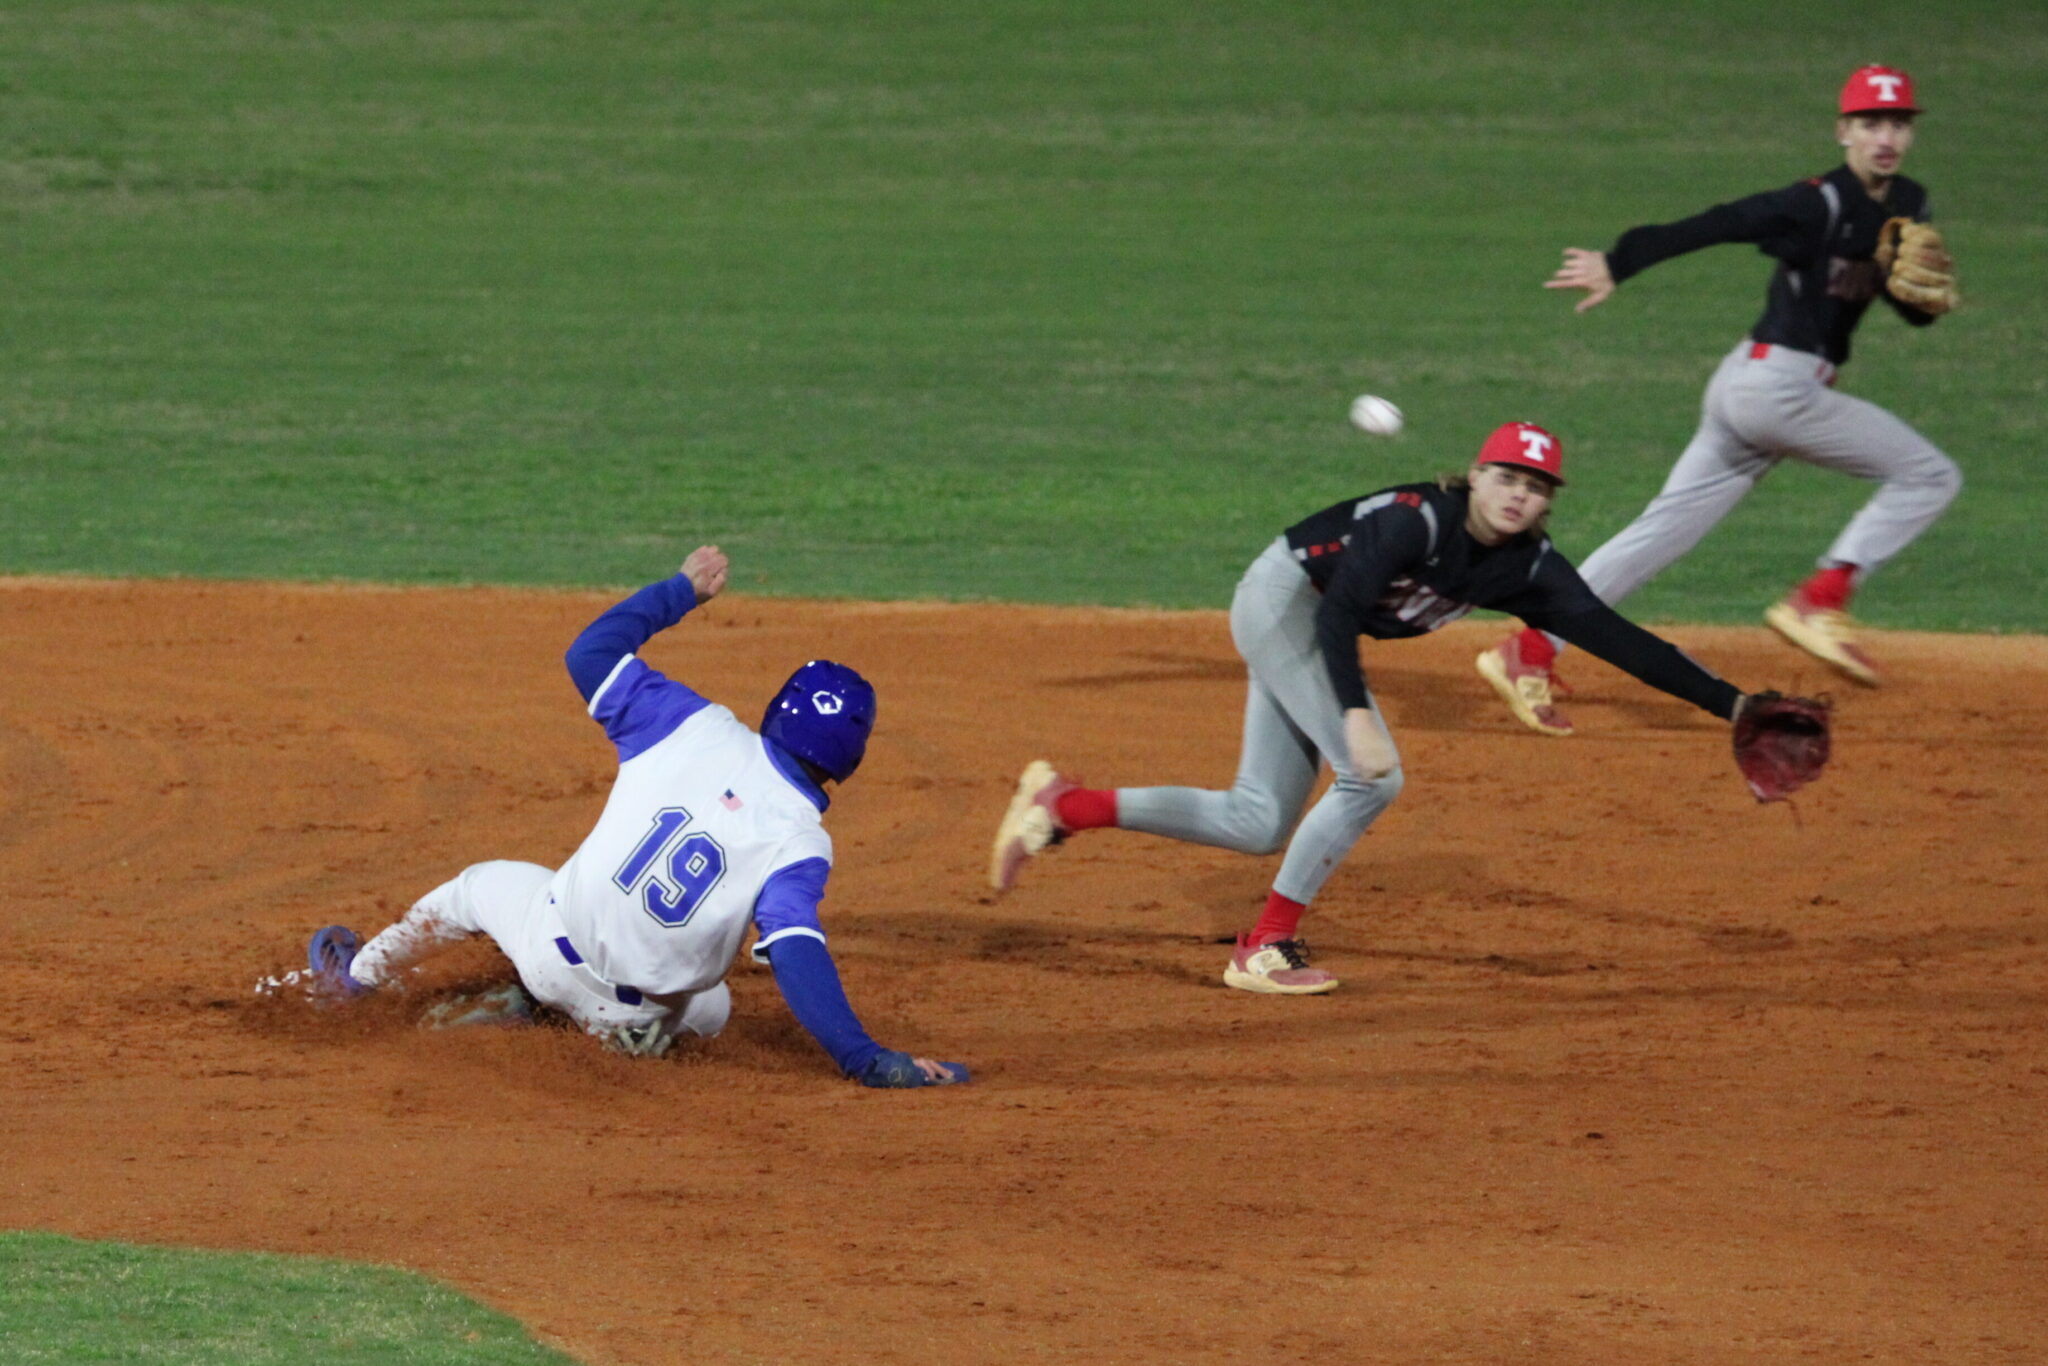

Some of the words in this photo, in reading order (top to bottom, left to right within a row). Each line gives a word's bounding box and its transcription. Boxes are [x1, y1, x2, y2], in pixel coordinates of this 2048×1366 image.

[1868, 75, 1903, 102] T
[1519, 430, 1552, 462] T
[612, 807, 727, 928] 19
